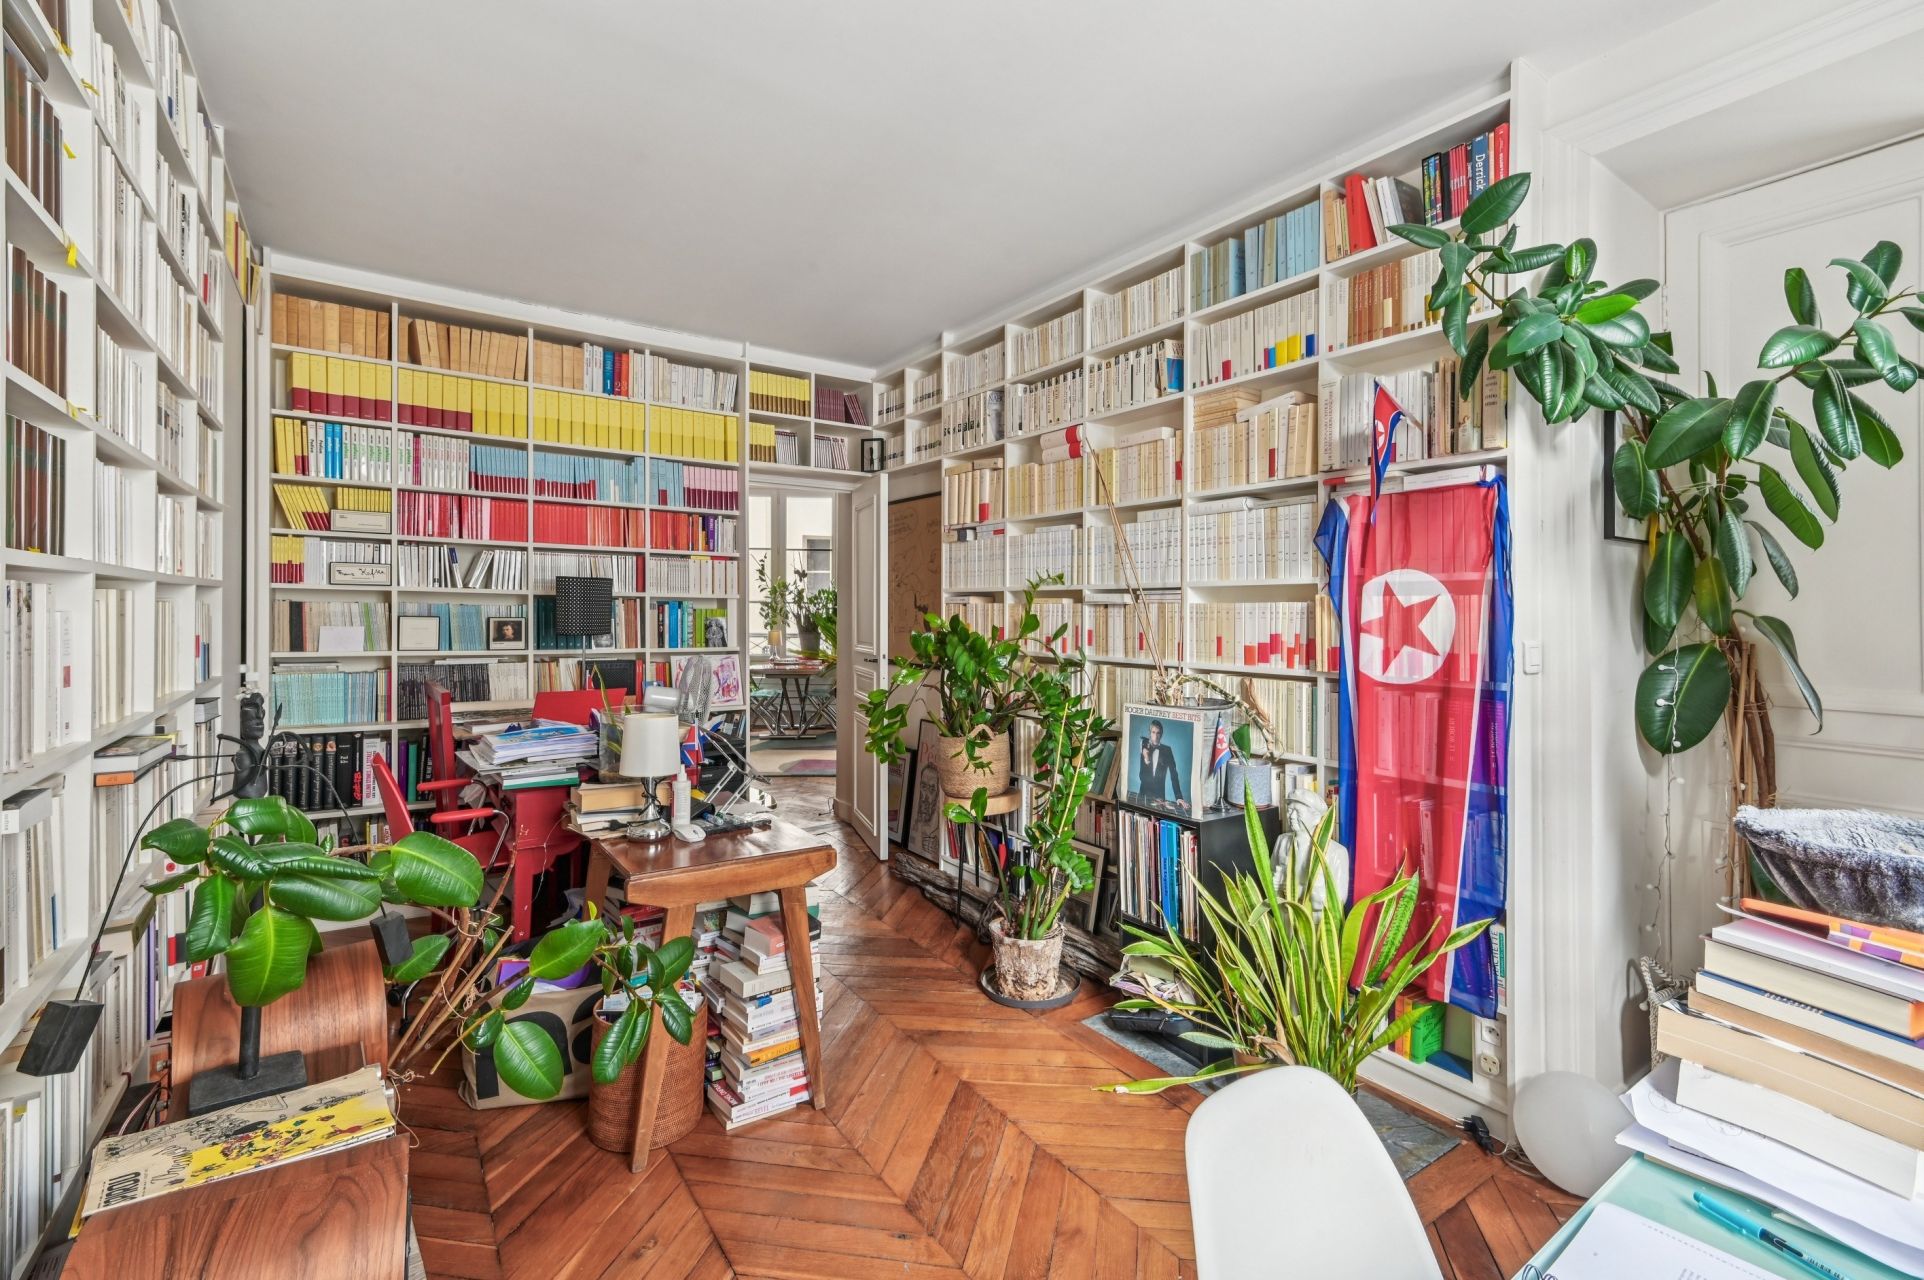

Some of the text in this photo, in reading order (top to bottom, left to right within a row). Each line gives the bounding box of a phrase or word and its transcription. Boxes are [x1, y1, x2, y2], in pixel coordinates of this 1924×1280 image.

[1475, 153, 1486, 191] Derrick
[1125, 706, 1202, 722] ROGER DALTREY BEST BITS
